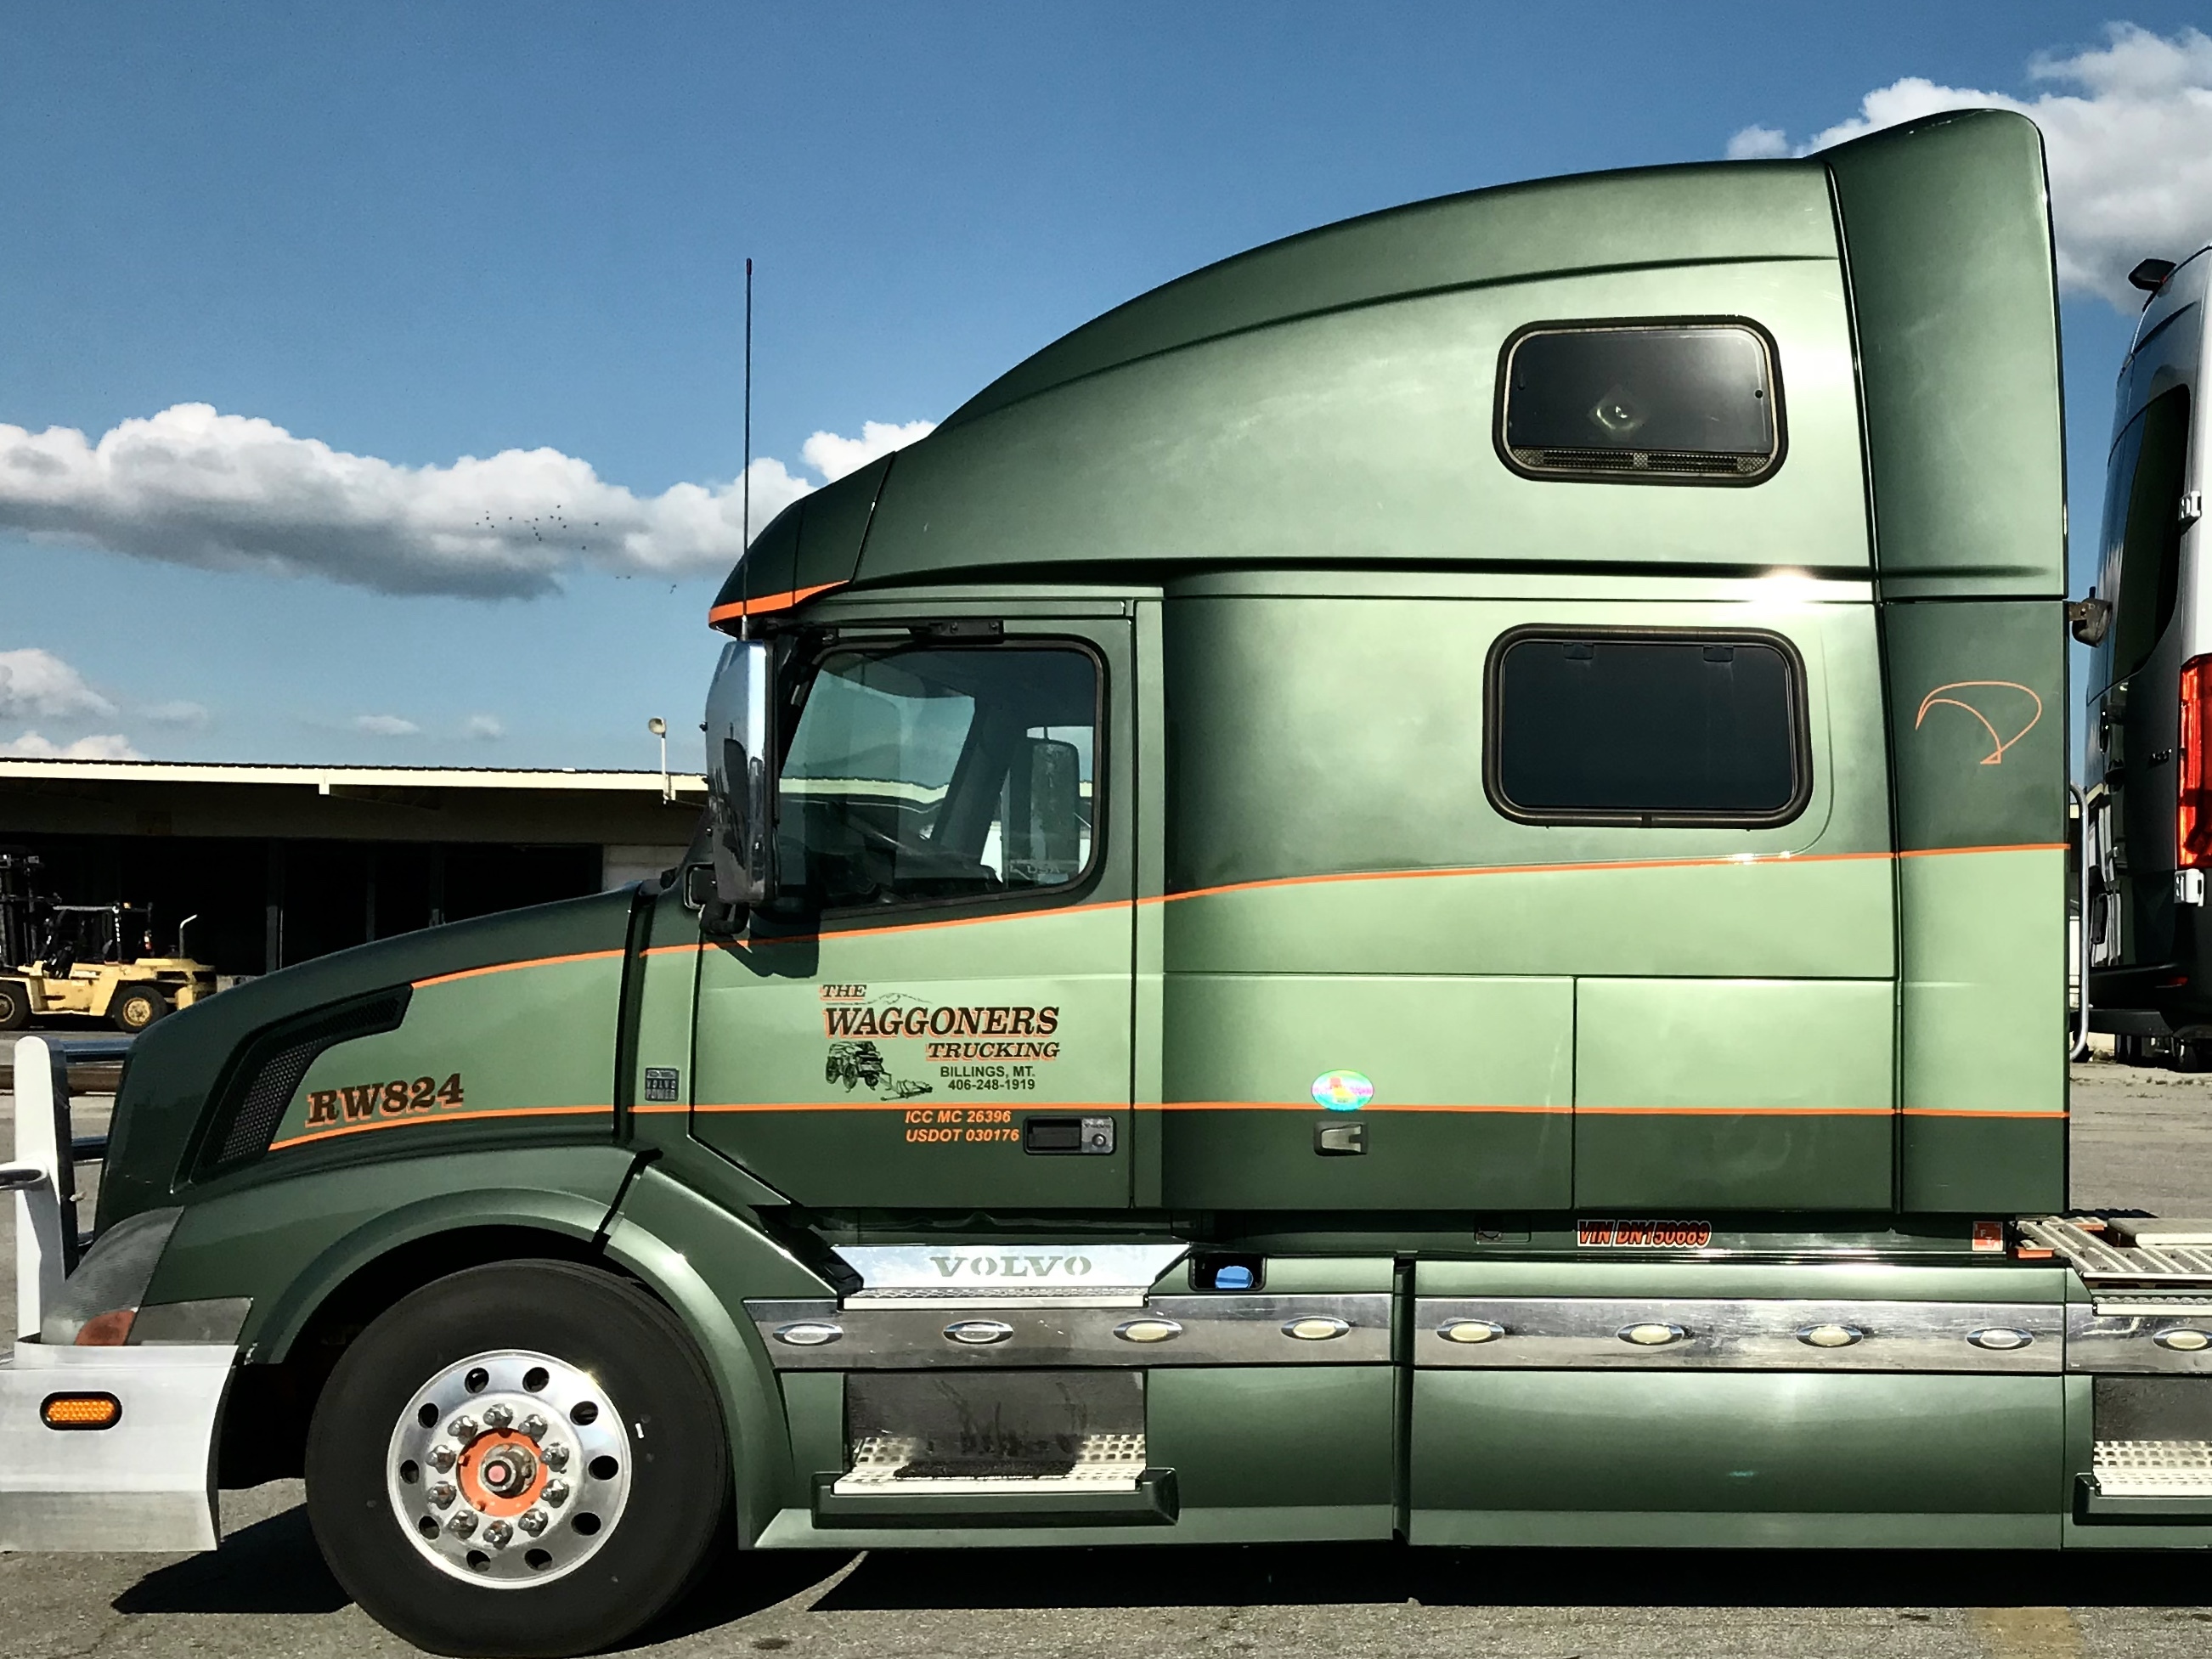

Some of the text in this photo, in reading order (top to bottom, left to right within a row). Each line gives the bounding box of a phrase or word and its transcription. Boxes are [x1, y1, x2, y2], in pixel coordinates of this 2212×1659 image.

[820, 984, 867, 1001] THE
[822, 1006, 1060, 1039] WAGGONERS
[926, 1041, 1061, 1061] TRUCKING
[940, 1066, 1035, 1079] BILLINGS, MT.
[948, 1079, 1035, 1091] 406-248-1919
[305, 1073, 464, 1128] RW824
[905, 1110, 1012, 1123] ICC MC 26396
[906, 1129, 1019, 1142] USDOT 030176
[1577, 1220, 1712, 1248] VIN DN150689
[929, 1256, 1092, 1277] VOLVO
